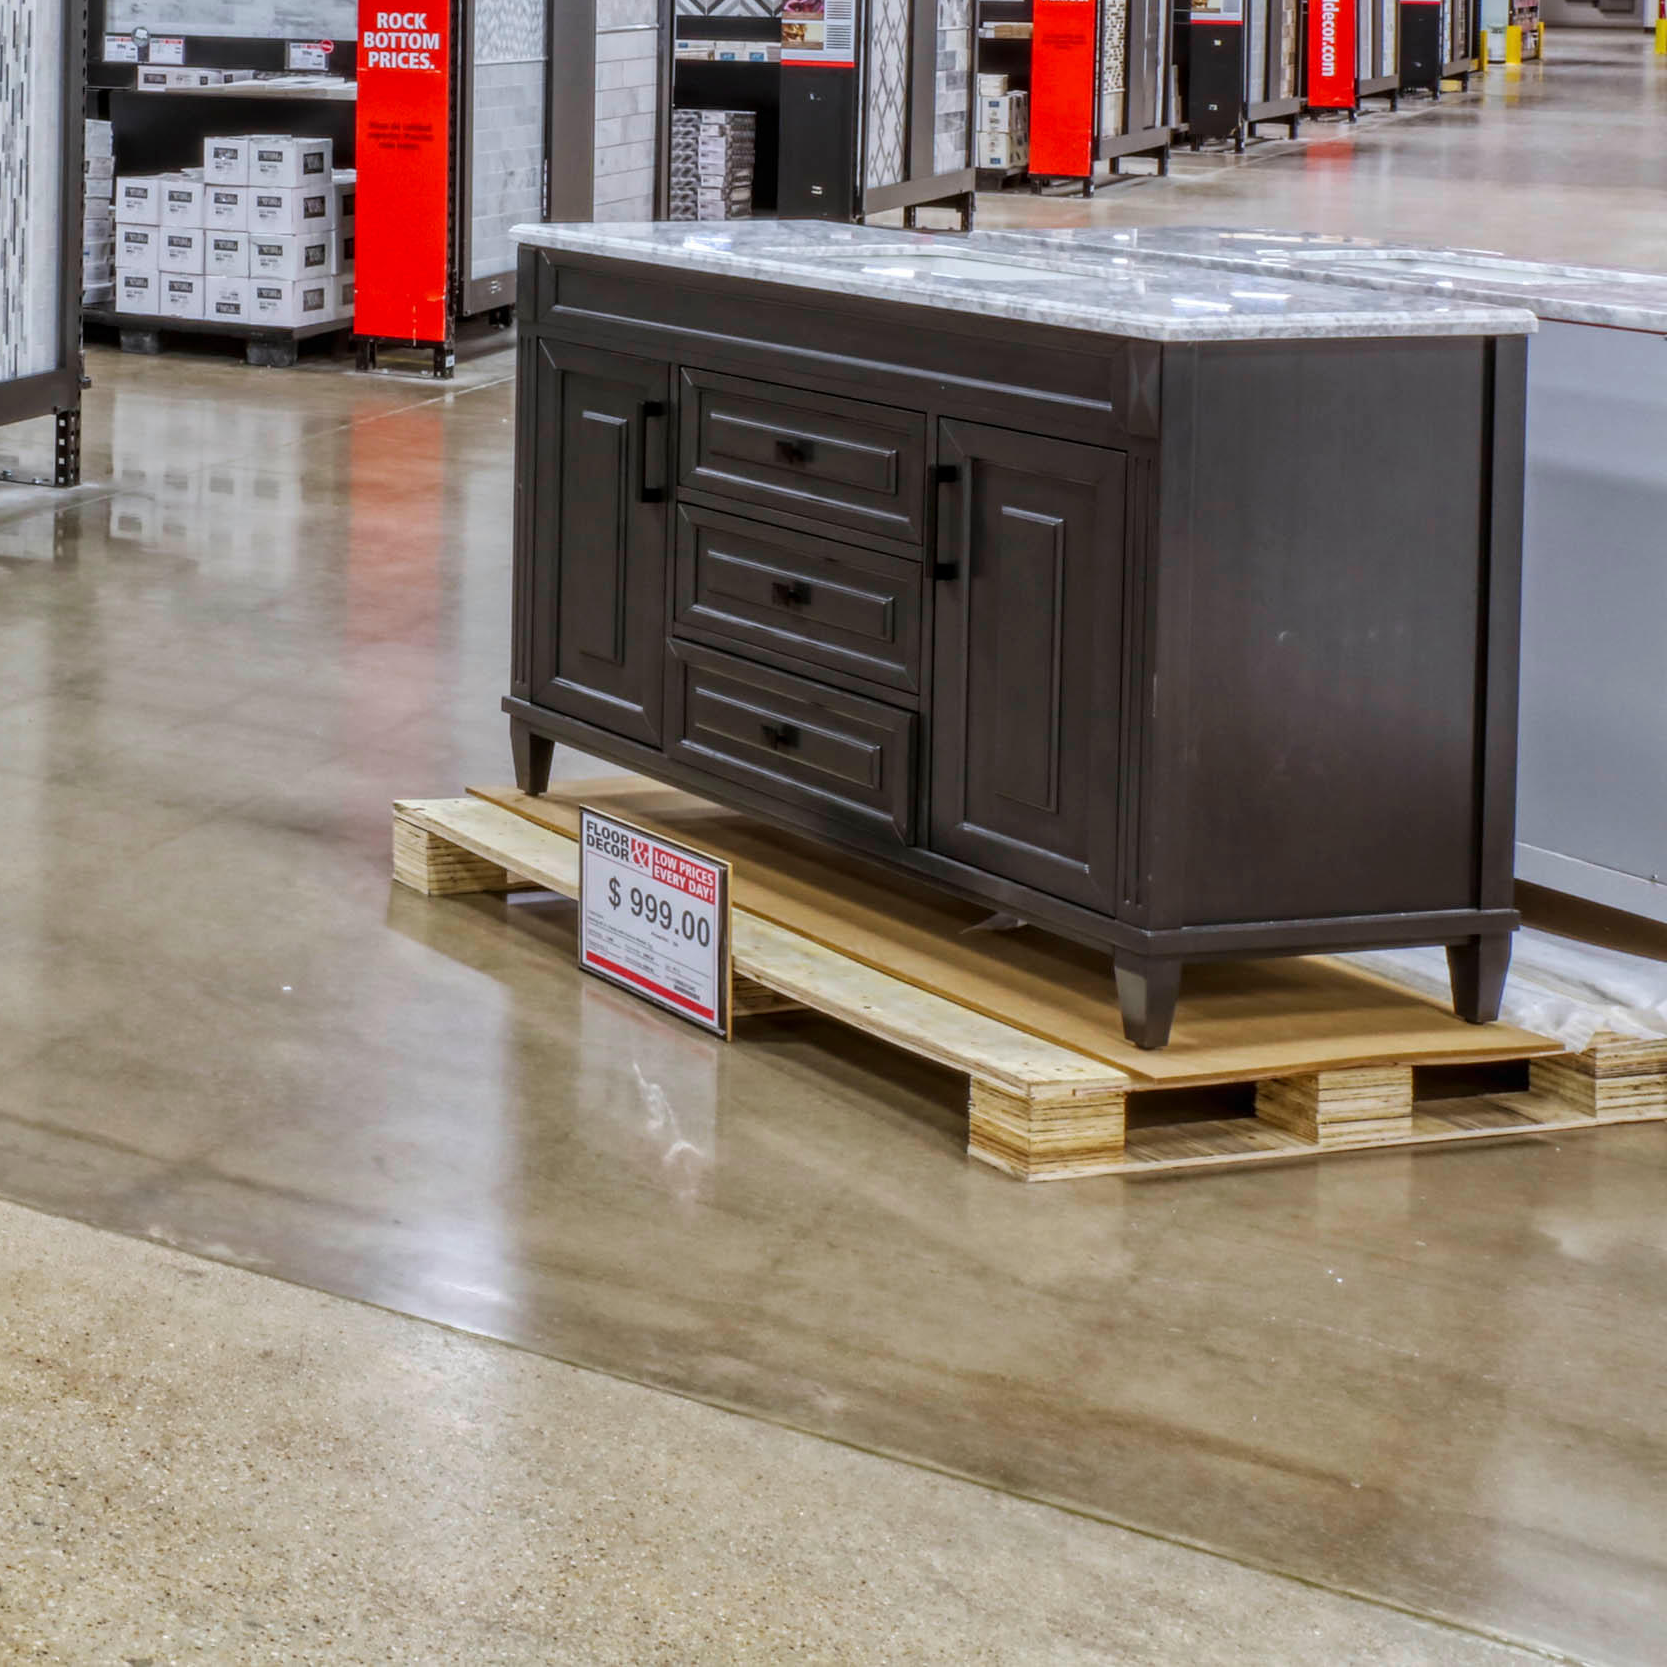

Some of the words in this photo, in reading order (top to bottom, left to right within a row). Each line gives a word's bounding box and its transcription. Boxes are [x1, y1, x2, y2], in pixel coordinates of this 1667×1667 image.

[377, 13, 427, 29] ROCK
[364, 32, 440, 50] BOTTOM
[368, 52, 436, 70] PRICES.
[586, 820, 629, 848] FLOOR
[631, 838, 650, 868] &
[586, 834, 629, 862] DECOR
[655, 849, 677, 871] LOW
[679, 859, 714, 886] PRICES
[654, 866, 686, 890] EVERY
[688, 880, 714, 903] DAY!
[608, 876, 622, 910] $
[630, 887, 710, 948] 999.00
